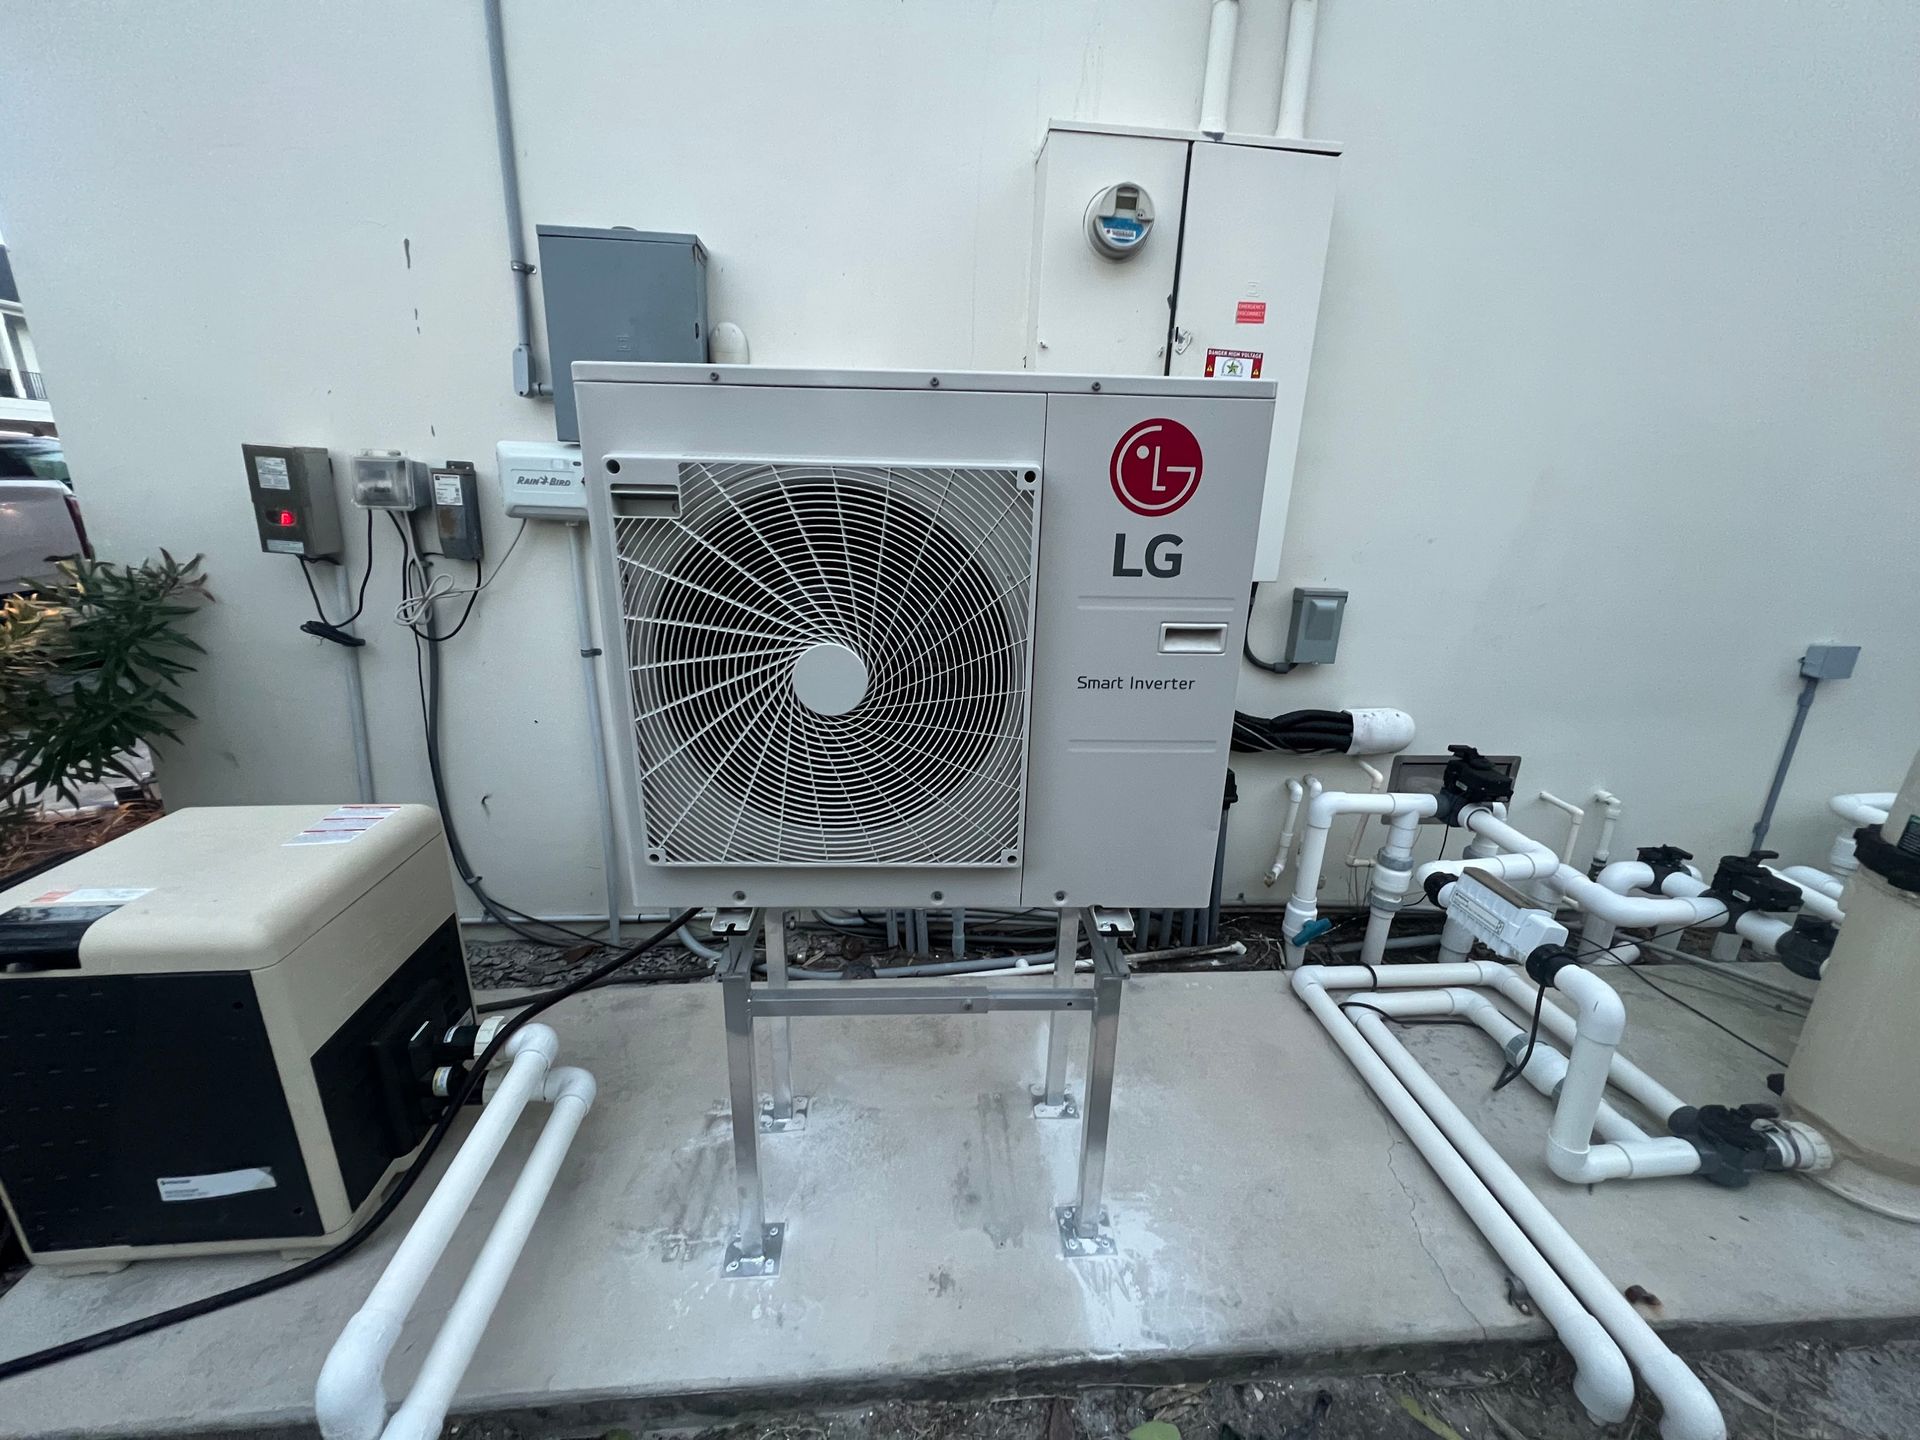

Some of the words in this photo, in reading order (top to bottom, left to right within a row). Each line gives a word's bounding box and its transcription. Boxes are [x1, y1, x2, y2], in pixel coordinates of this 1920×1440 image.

[1113, 533, 1183, 578] LG
[1077, 676, 1123, 690] Smart
[1130, 676, 1195, 690] Inverter
